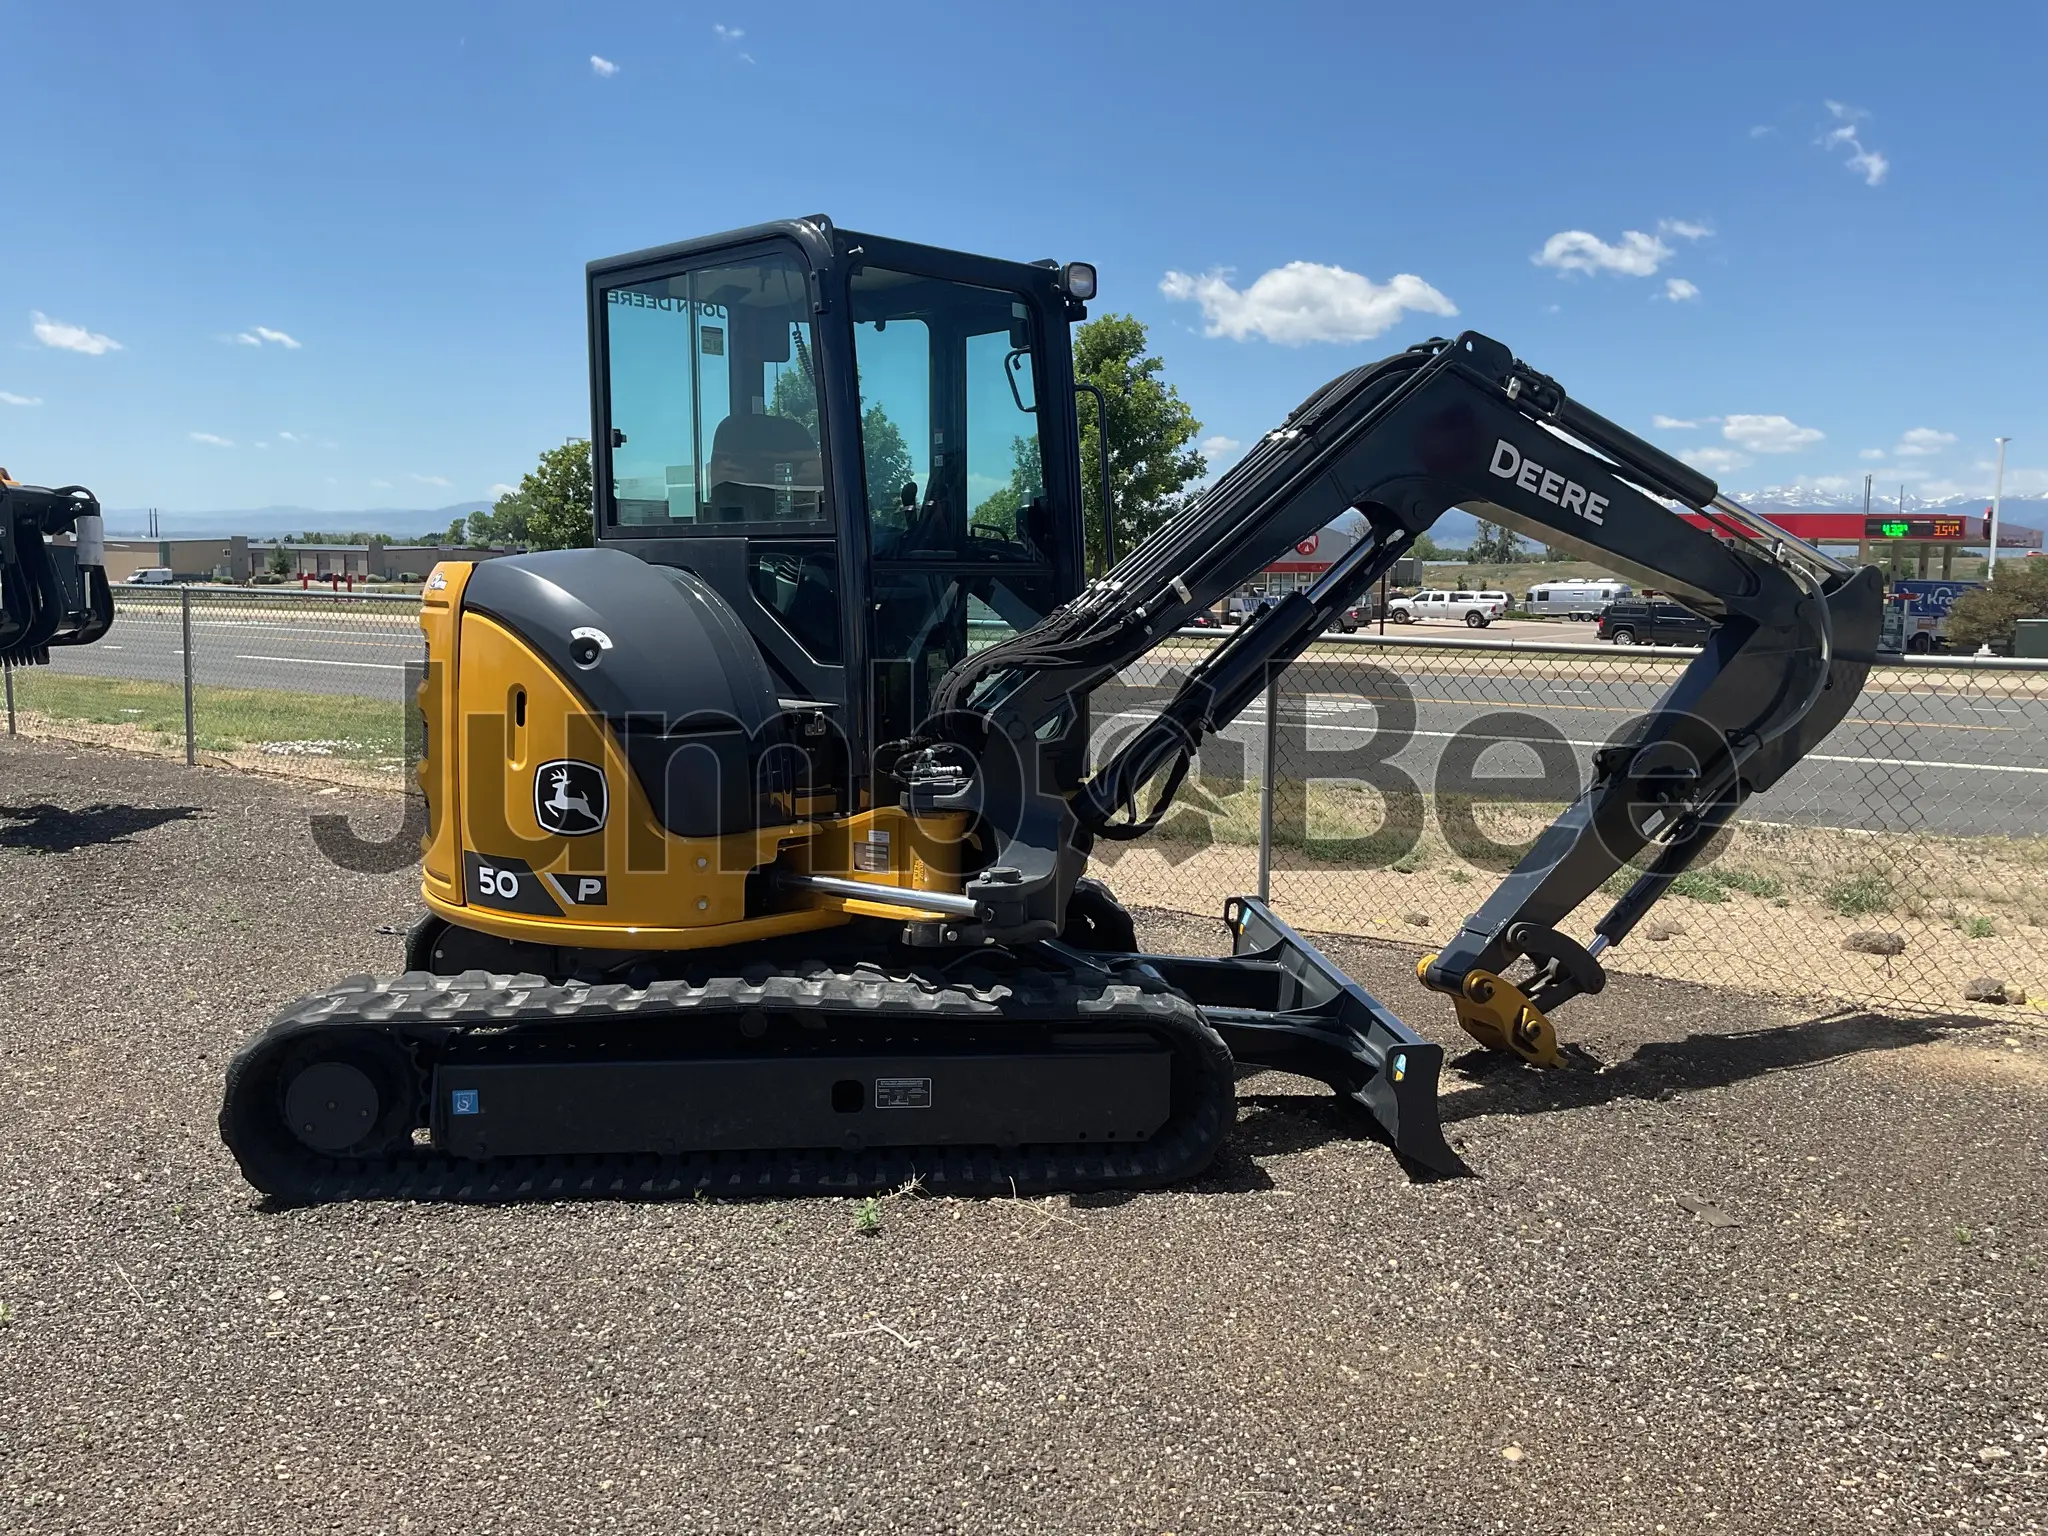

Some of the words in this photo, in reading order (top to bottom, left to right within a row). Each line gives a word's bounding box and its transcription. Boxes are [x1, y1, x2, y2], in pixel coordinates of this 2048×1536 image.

[1488, 438, 1610, 526] DEERE
[479, 866, 519, 899] 50
[577, 878, 602, 902] P
